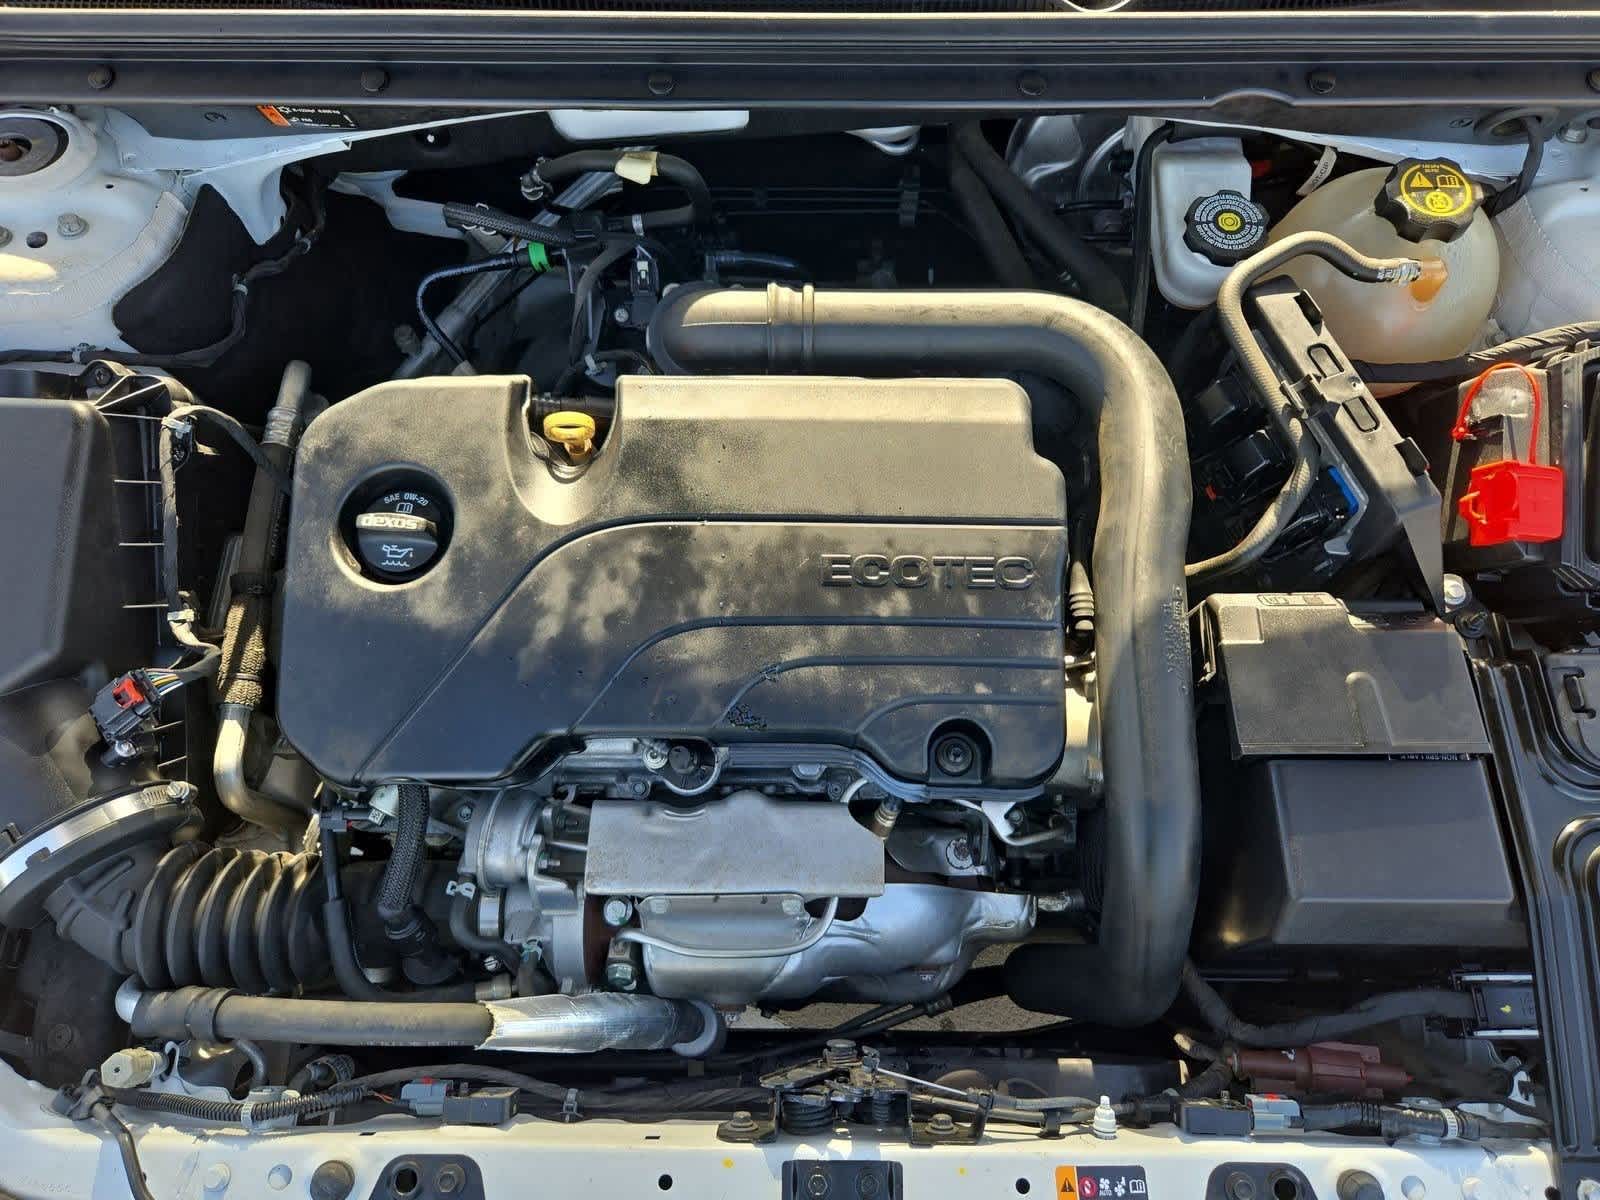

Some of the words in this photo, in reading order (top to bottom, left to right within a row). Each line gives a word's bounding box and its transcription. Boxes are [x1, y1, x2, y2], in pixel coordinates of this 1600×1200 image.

[383, 493, 400, 504] SAE
[403, 492, 429, 506] 0W-20
[821, 554, 1034, 591] ECOTEC
